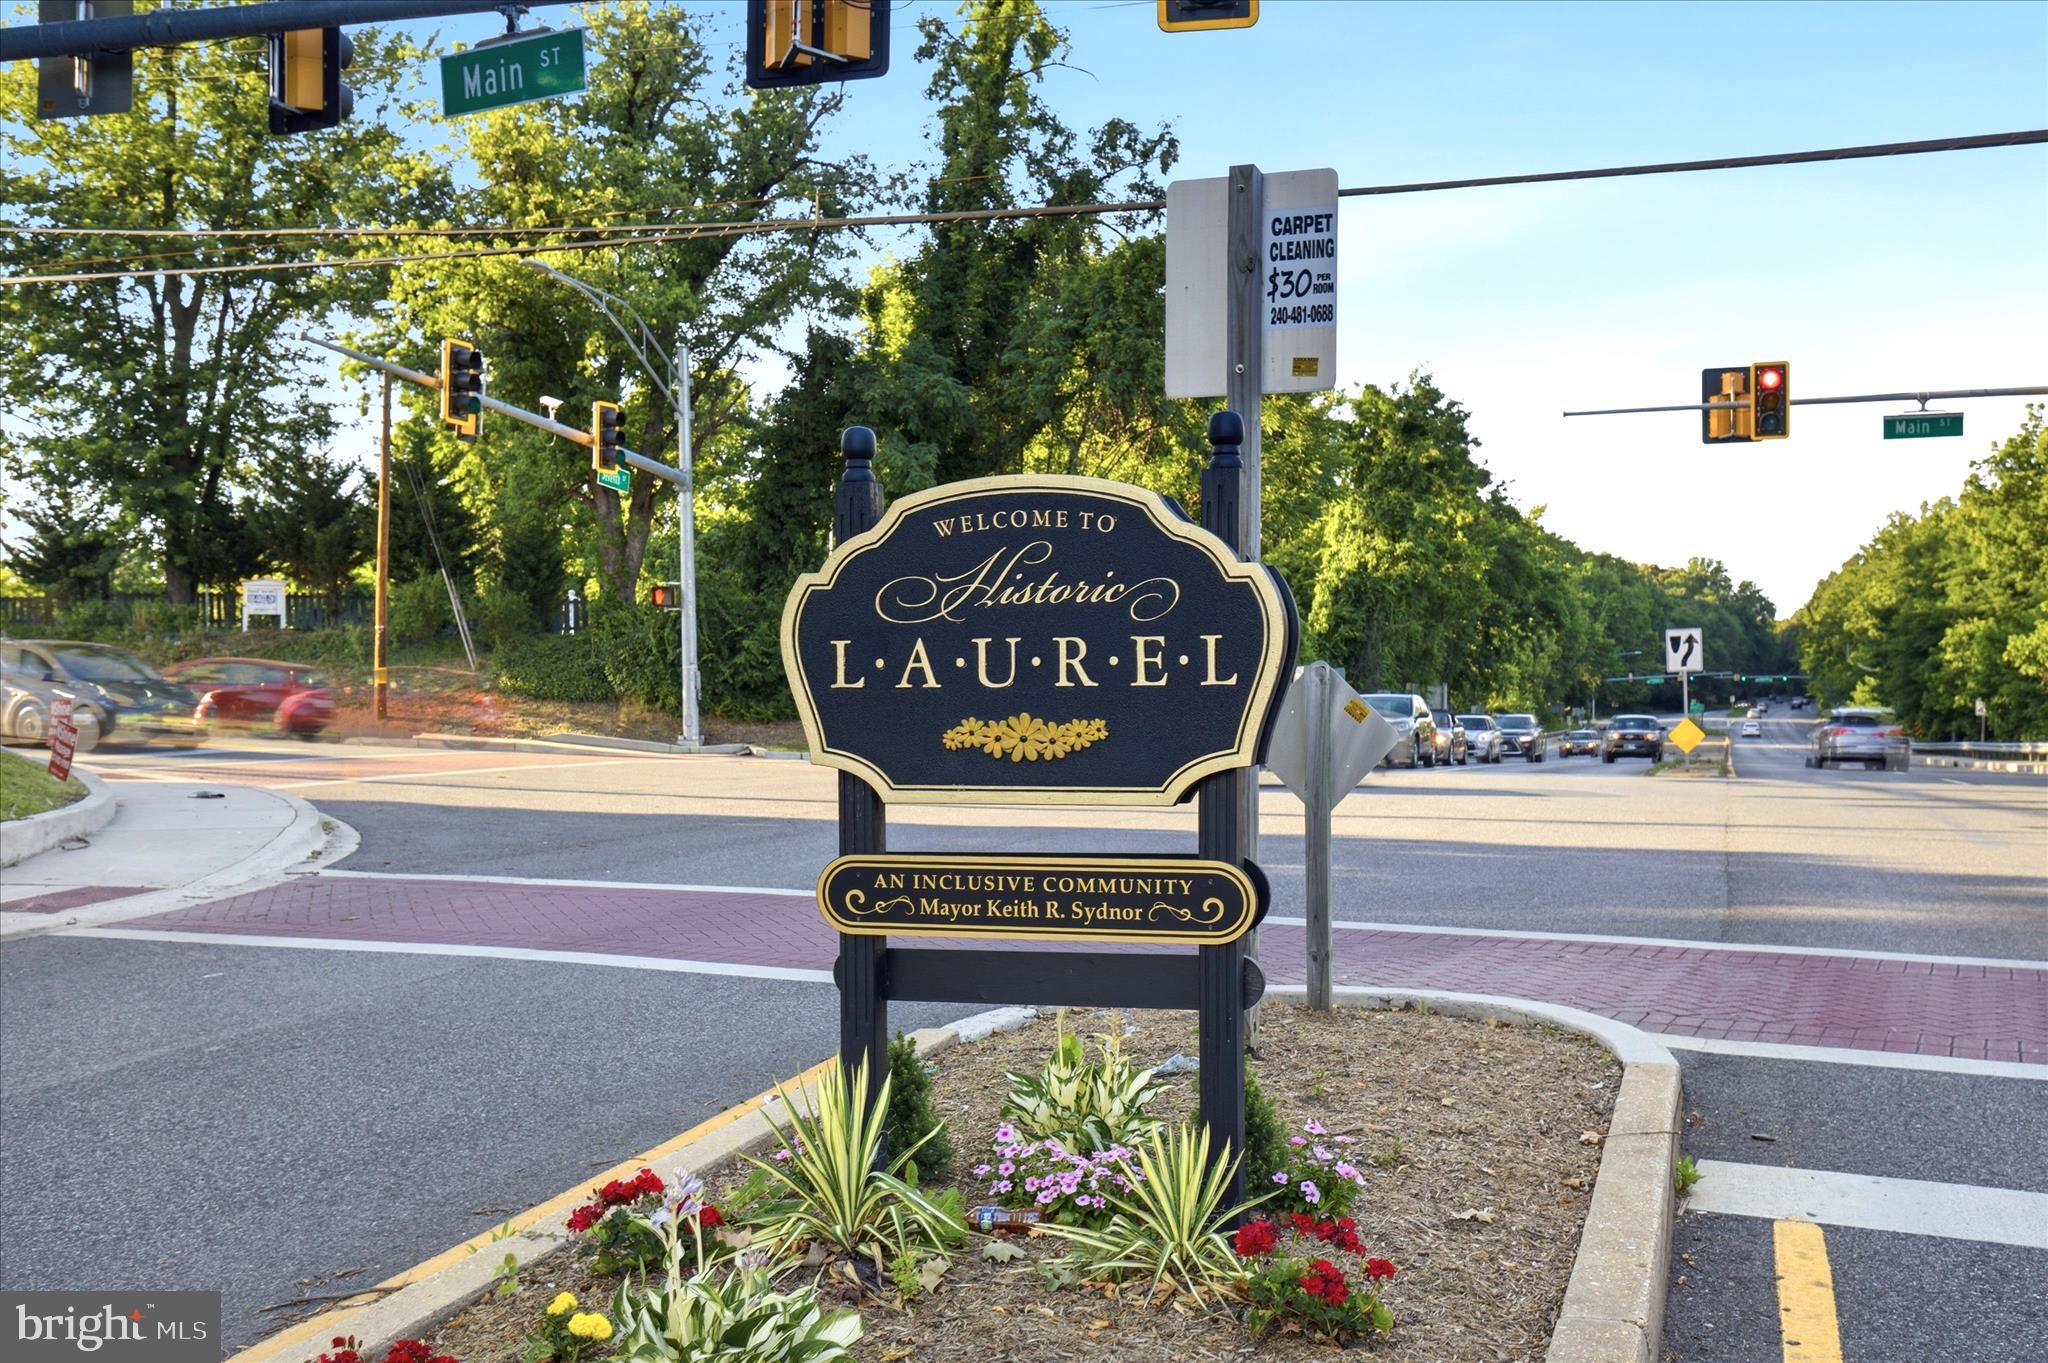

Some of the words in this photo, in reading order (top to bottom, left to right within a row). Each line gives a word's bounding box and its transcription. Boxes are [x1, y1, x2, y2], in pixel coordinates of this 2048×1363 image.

[463, 59, 524, 100] Main
[539, 46, 561, 68] ST
[1271, 213, 1333, 236] CARPET
[1269, 238, 1334, 262] CLEANING
[1267, 267, 1312, 303] $30
[1313, 282, 1334, 294] ROOM
[1317, 273, 1331, 281] PER
[1271, 304, 1333, 325] 240-481-0688
[1895, 420, 1930, 434] Main
[1940, 418, 1952, 426] ST
[933, 510, 1068, 538] WELCOME
[1080, 511, 1116, 533] TO
[875, 541, 1180, 624] Historic
[874, 874, 904, 889] AN
[913, 874, 1034, 892] INCLUSIVE
[1043, 877, 1193, 895] COMMUNITY
[920, 898, 981, 921] Mayor
[986, 899, 1039, 918] Keith
[1045, 901, 1066, 919] R.
[1071, 901, 1143, 925] Sydnor
